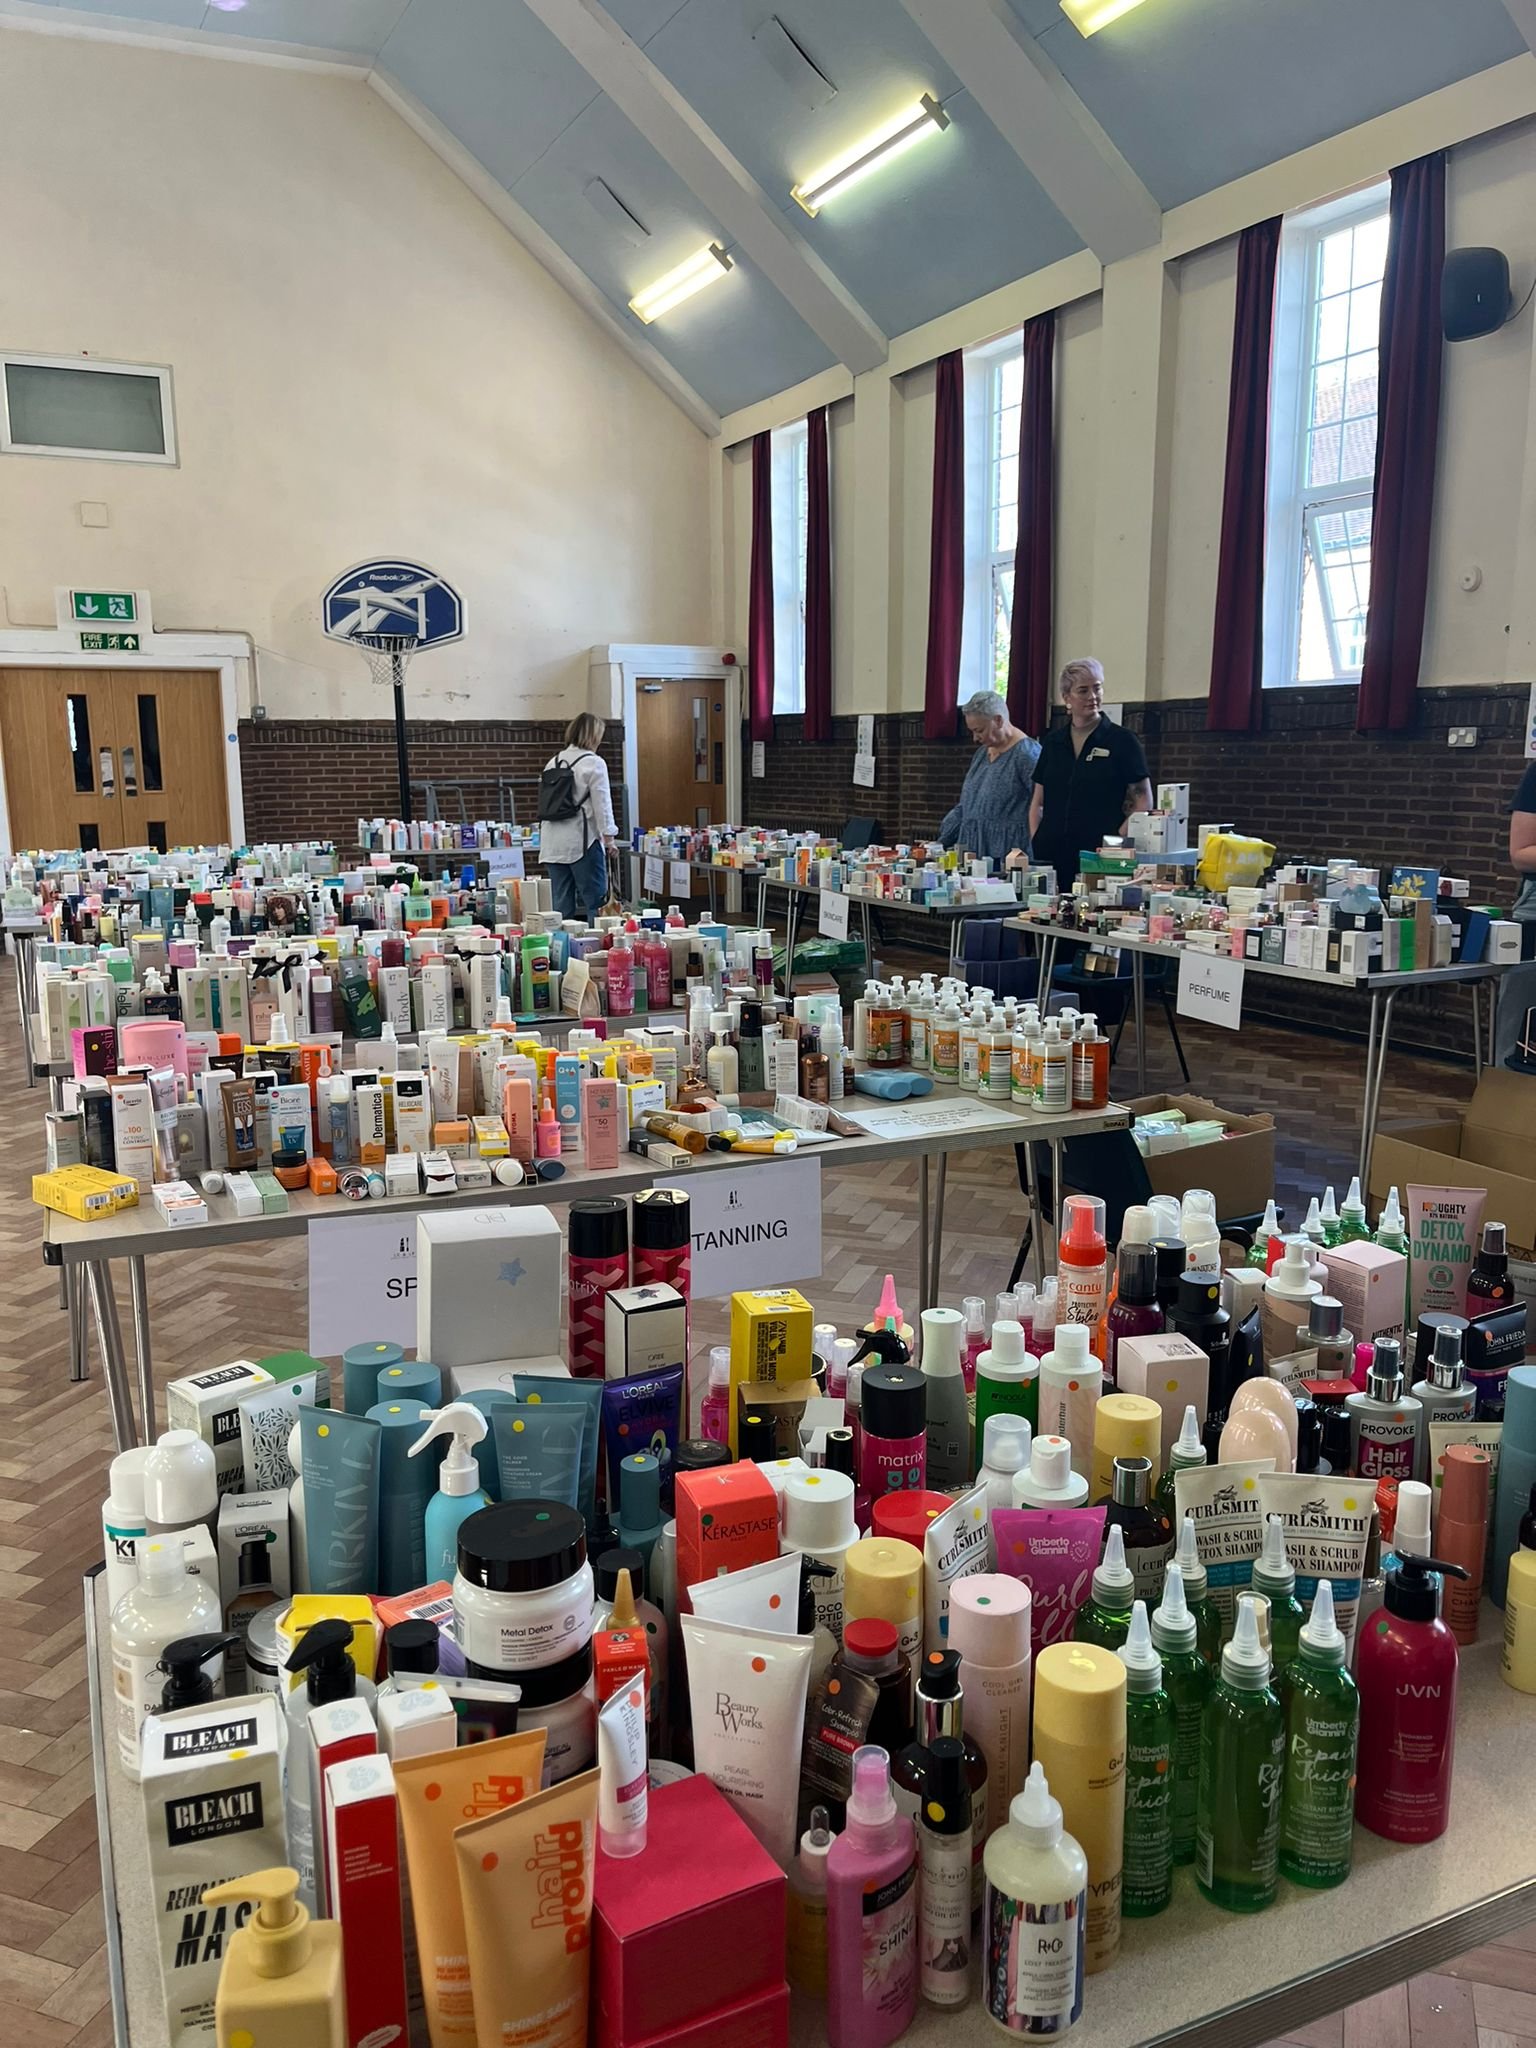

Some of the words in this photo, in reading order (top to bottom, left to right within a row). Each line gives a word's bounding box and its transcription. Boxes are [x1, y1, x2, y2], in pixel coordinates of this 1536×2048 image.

[82, 633, 103, 641] FIRE
[117, 987, 133, 1016] hello
[1188, 983, 1231, 1002] PERFUME
[398, 991, 410, 1024] Body
[434, 991, 446, 1025] Body
[100, 1031, 116, 1072] he-shi
[558, 1066, 577, 1075] Q+A
[232, 1101, 253, 1114] LEGS
[373, 1092, 384, 1139] Dermatica
[691, 1219, 788, 1251] TANNING
[1420, 1220, 1465, 1241] DETOX
[1413, 1241, 1472, 1263] DYNAMO
[385, 1277, 418, 1299] SP
[1069, 1282, 1101, 1293] cantu
[1066, 1306, 1099, 1324] Styles
[1371, 1323, 1403, 1342] AUTHENTIC
[1486, 1337, 1505, 1348] JOHN
[1505, 1330, 1526, 1342] FRIEDA
[195, 1366, 248, 1385] BLEACH
[622, 1381, 668, 1399] L'ORÉAL
[620, 1395, 674, 1420] ELVIVE
[1433, 1407, 1476, 1422] PROVOKE
[216, 1416, 241, 1434] BLE
[226, 1429, 241, 1438] LON
[1360, 1422, 1415, 1436] PROVOKE
[878, 1451, 924, 1467] matrix
[1368, 1448, 1405, 1464] Hair
[1361, 1462, 1411, 1479] Gloss
[1185, 1500, 1261, 1519] CURLSMIT
[701, 1517, 776, 1542] KÉRASTASE
[1224, 1531, 1231, 1542] &
[115, 1538, 136, 1557] K1
[1028, 1537, 1070, 1547] Umberto
[1030, 1545, 1069, 1555] Giannini
[1284, 1544, 1307, 1556] ASH
[1310, 1545, 1317, 1556] &
[1320, 1546, 1360, 1559] SCRUB
[1310, 1559, 1363, 1573] SHAMPOO
[500, 1627, 527, 1637] Metal
[528, 1623, 554, 1636] Detox
[1031, 1608, 1076, 1645] ell
[982, 1680, 1006, 1689] COOL
[1008, 1677, 1024, 1686] GIRL
[986, 1686, 1022, 1697] CLEANSE
[1396, 1684, 1441, 1699] JVN
[715, 1692, 760, 1718] Beauty
[625, 1700, 640, 1742] PHILIP
[829, 1719, 860, 1739] Shampoo
[1305, 1716, 1347, 1730] Umberto
[172, 1723, 250, 1751] BLEACH
[619, 1706, 638, 1767] KINGSLEY
[823, 1729, 837, 1742] PURE
[836, 1735, 855, 1750] BROWN
[1306, 1726, 1346, 1737] Giannini
[186, 1741, 237, 1755] LONDON
[1128, 1743, 1170, 1753] Umberto
[1291, 1733, 1355, 1770] Repair
[1129, 1752, 1169, 1763] Giannini
[724, 1764, 750, 1775] PEARL
[1295, 1760, 1350, 1782] Juice
[712, 1772, 765, 1790] NOURISHING
[745, 1792, 764, 1800] MASK
[174, 1790, 255, 1830] BLEACH
[190, 1819, 241, 1837] LONDON
[525, 1833, 566, 1929] hair
[548, 1820, 592, 1955] proud
[877, 1885, 898, 1901] JOHN
[181, 1901, 252, 1941] MAS
[174, 1933, 222, 1969] MA
[435, 1956, 468, 1967] SHIN
